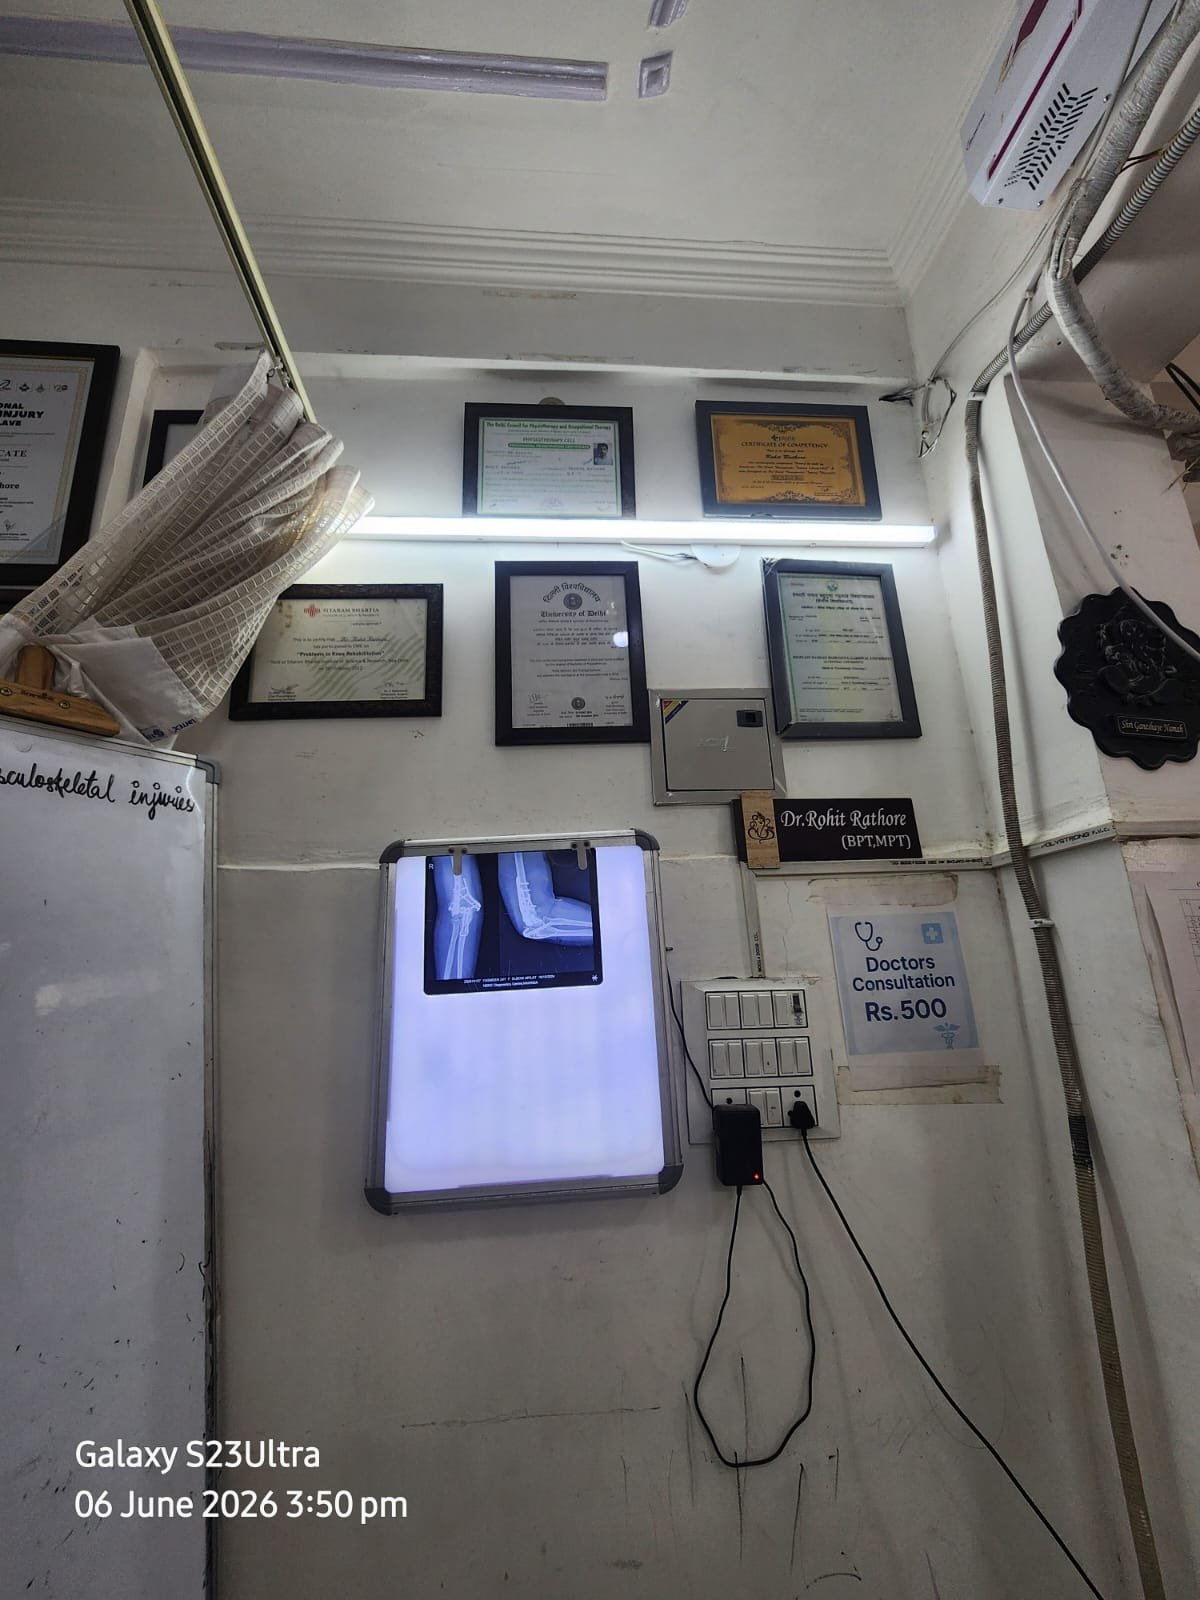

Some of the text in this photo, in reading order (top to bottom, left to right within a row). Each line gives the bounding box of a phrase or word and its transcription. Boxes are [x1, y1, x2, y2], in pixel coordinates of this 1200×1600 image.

[540, 610, 577, 618] University
[128, 780, 195, 820] injuries
[849, 807, 907, 830] Rathore
[841, 834, 911, 851] (BPT,MPT)
[866, 956, 936, 973] Doctors
[852, 973, 955, 992] Consultation
